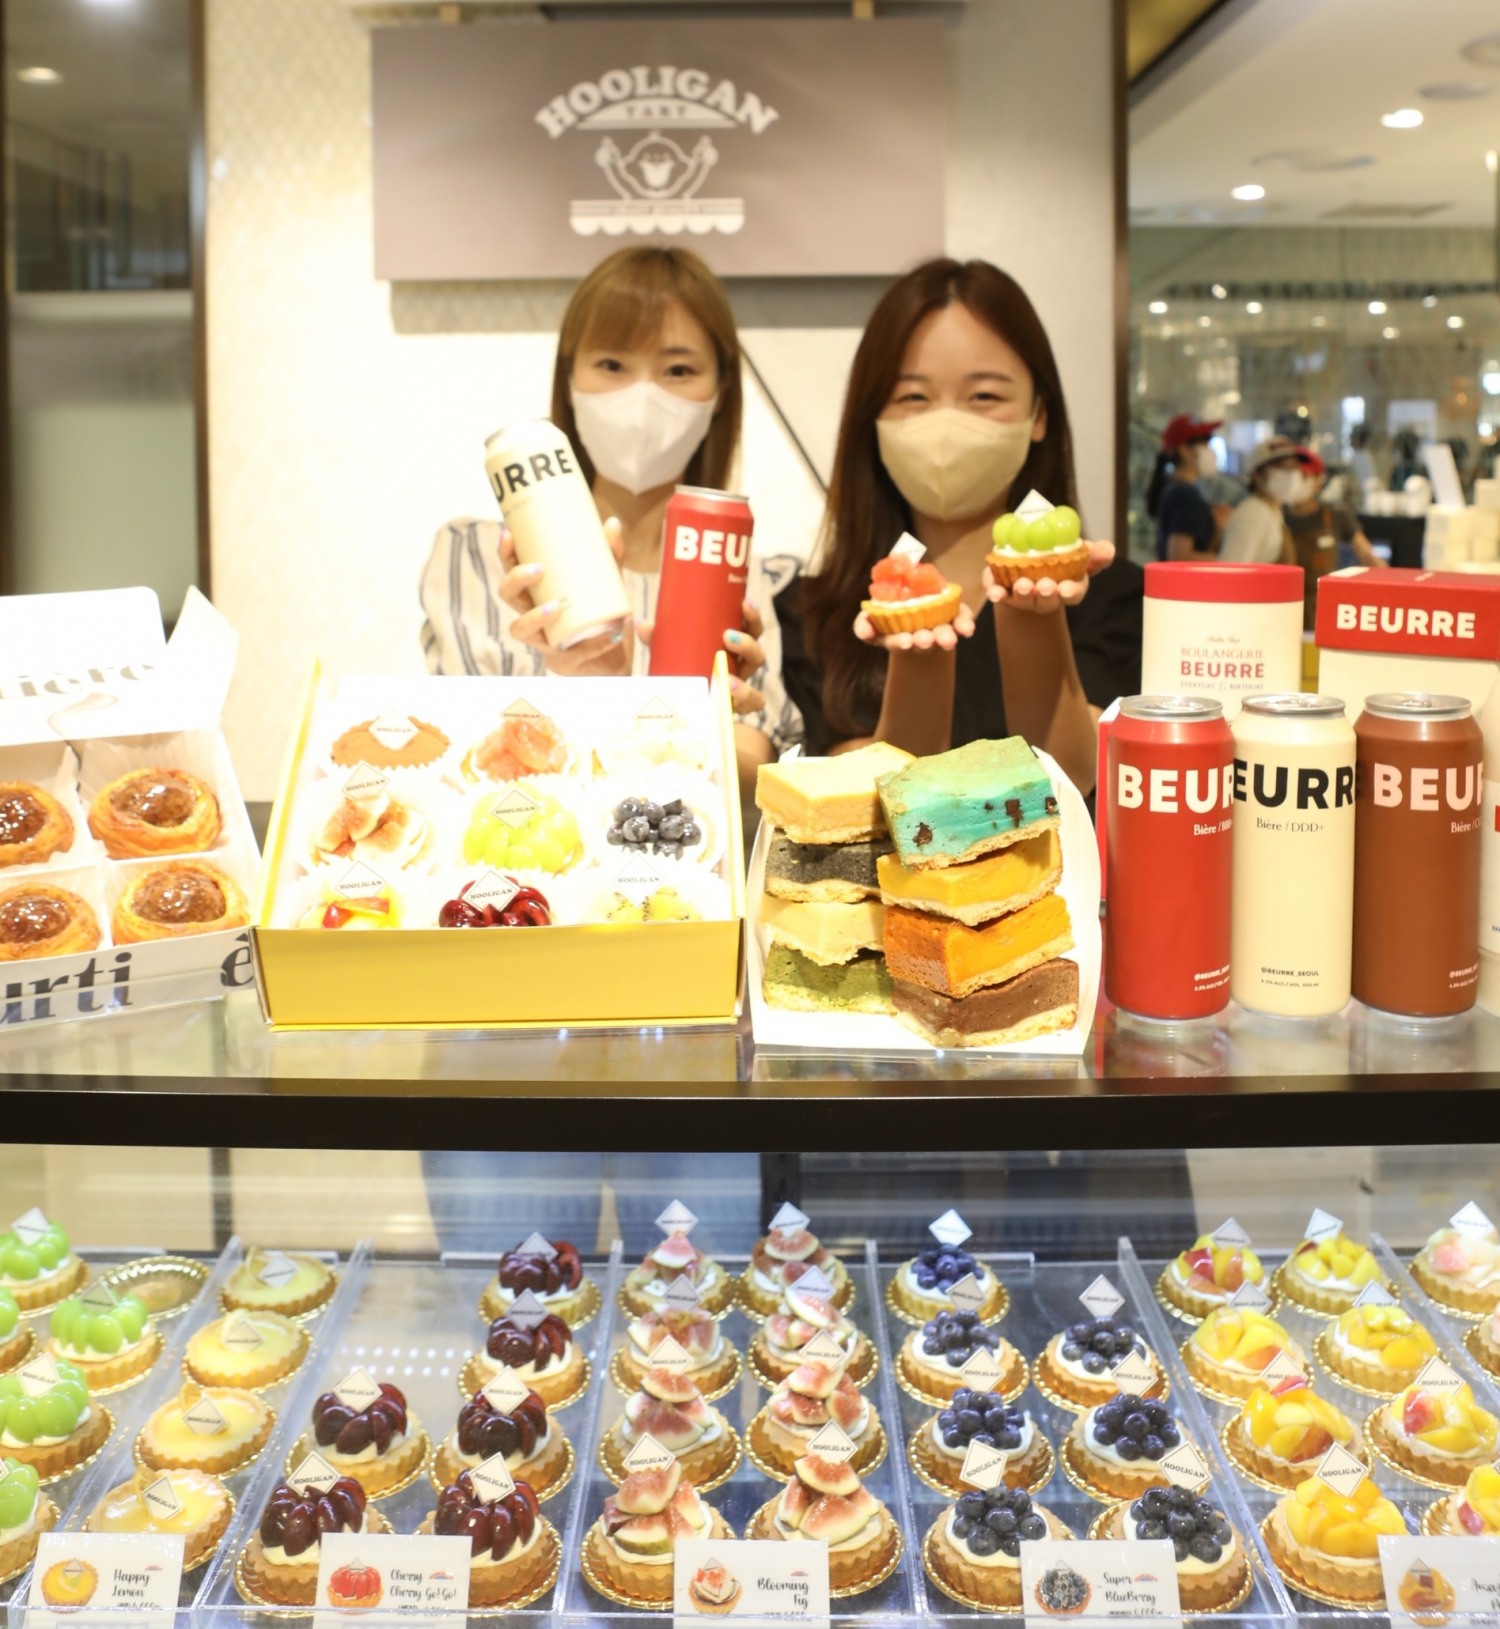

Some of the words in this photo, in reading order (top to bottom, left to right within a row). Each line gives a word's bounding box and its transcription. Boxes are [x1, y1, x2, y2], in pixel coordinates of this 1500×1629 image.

[534, 65, 780, 139] HOOLIGAN
[626, 105, 686, 117] TART
[1336, 603, 1476, 639] BEURRE
[1181, 646, 1265, 660] BOULANGERIE
[1181, 660, 1265, 679] BEURRE
[346, 779, 385, 791] HOOLIGAN
[495, 806, 535, 815] HOOLIGAN
[1193, 823, 1217, 836] Bière
[1256, 817, 1282, 831] Bière
[1450, 821, 1471, 833] Bière
[340, 880, 382, 890] HOOLIGAN
[618, 876, 660, 884] HOOLIGAN
[470, 888, 513, 900] HOOLIGAN
[1116, 1372, 1152, 1380] HOOLIGAN
[1421, 1379, 1459, 1387] HOOLIGAN
[813, 1443, 851, 1452] HOOLIGAN
[629, 1456, 669, 1467] HOOLIGAN
[966, 1457, 1002, 1478] HOOLIGAN
[1164, 1462, 1206, 1479] HOOLIGAN
[1322, 1467, 1362, 1478] HOOLIGAN
[294, 1474, 334, 1485] HOOLIGAN
[474, 1473, 509, 1490] HOOLIGAN
[146, 1493, 176, 1510] HOOLIGAN
[114, 1568, 150, 1587] Happy
[390, 1569, 422, 1585] Cherry
[1103, 1572, 1132, 1585] Super
[757, 1577, 809, 1595] Blooming
[390, 1585, 421, 1601] Cherry
[1105, 1591, 1156, 1605] BlueBerry
[793, 1594, 808, 1609] Fig
